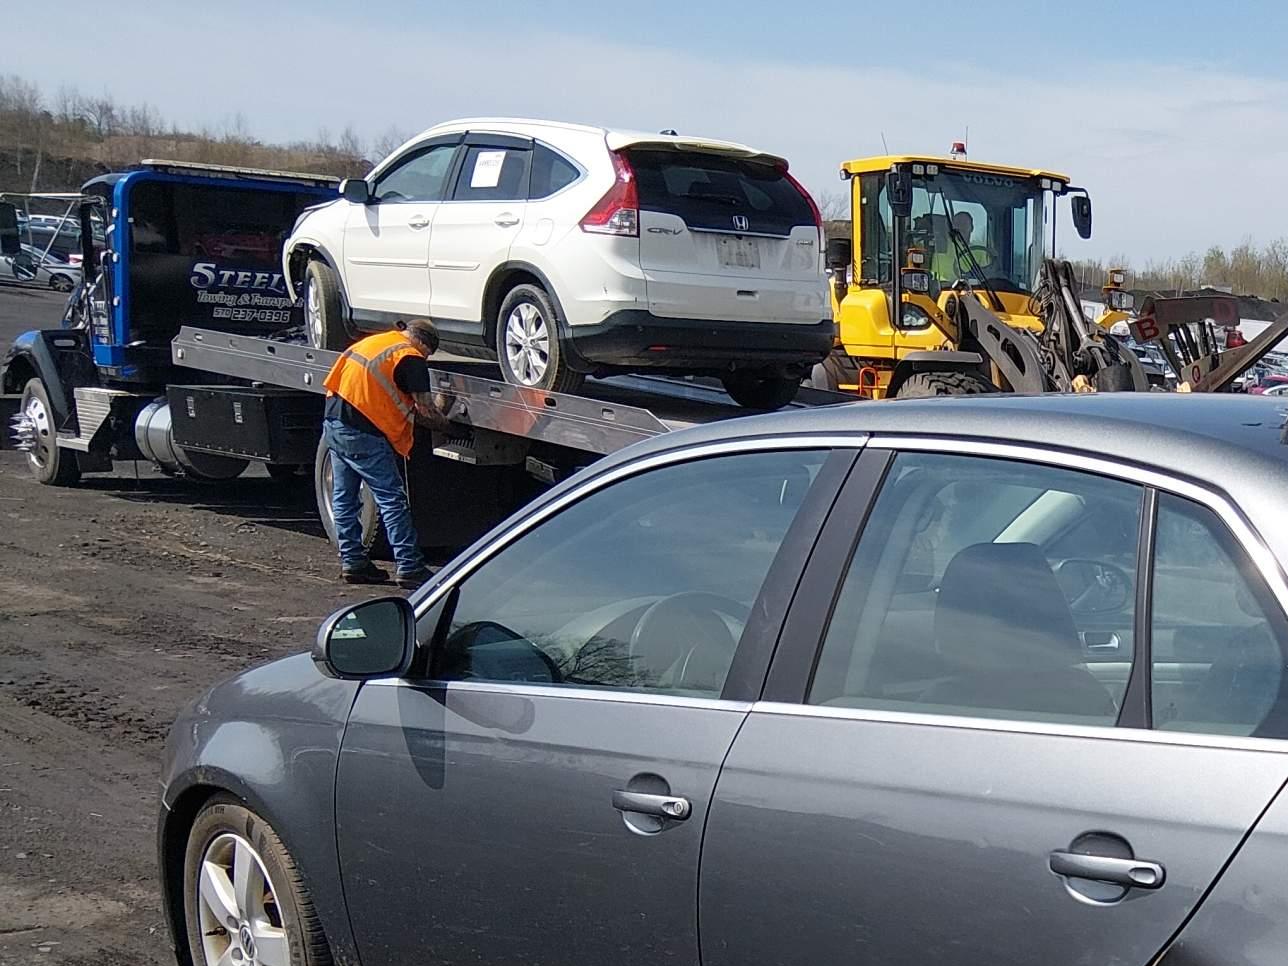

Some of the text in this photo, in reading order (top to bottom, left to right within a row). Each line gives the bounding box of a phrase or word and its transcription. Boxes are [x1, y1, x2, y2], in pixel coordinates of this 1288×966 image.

[963, 173, 1014, 188] VOLVO
[197, 290, 304, 309] Towing & Transpot
[231, 308, 290, 323] 237-0396
[1137, 317, 1160, 340] B
